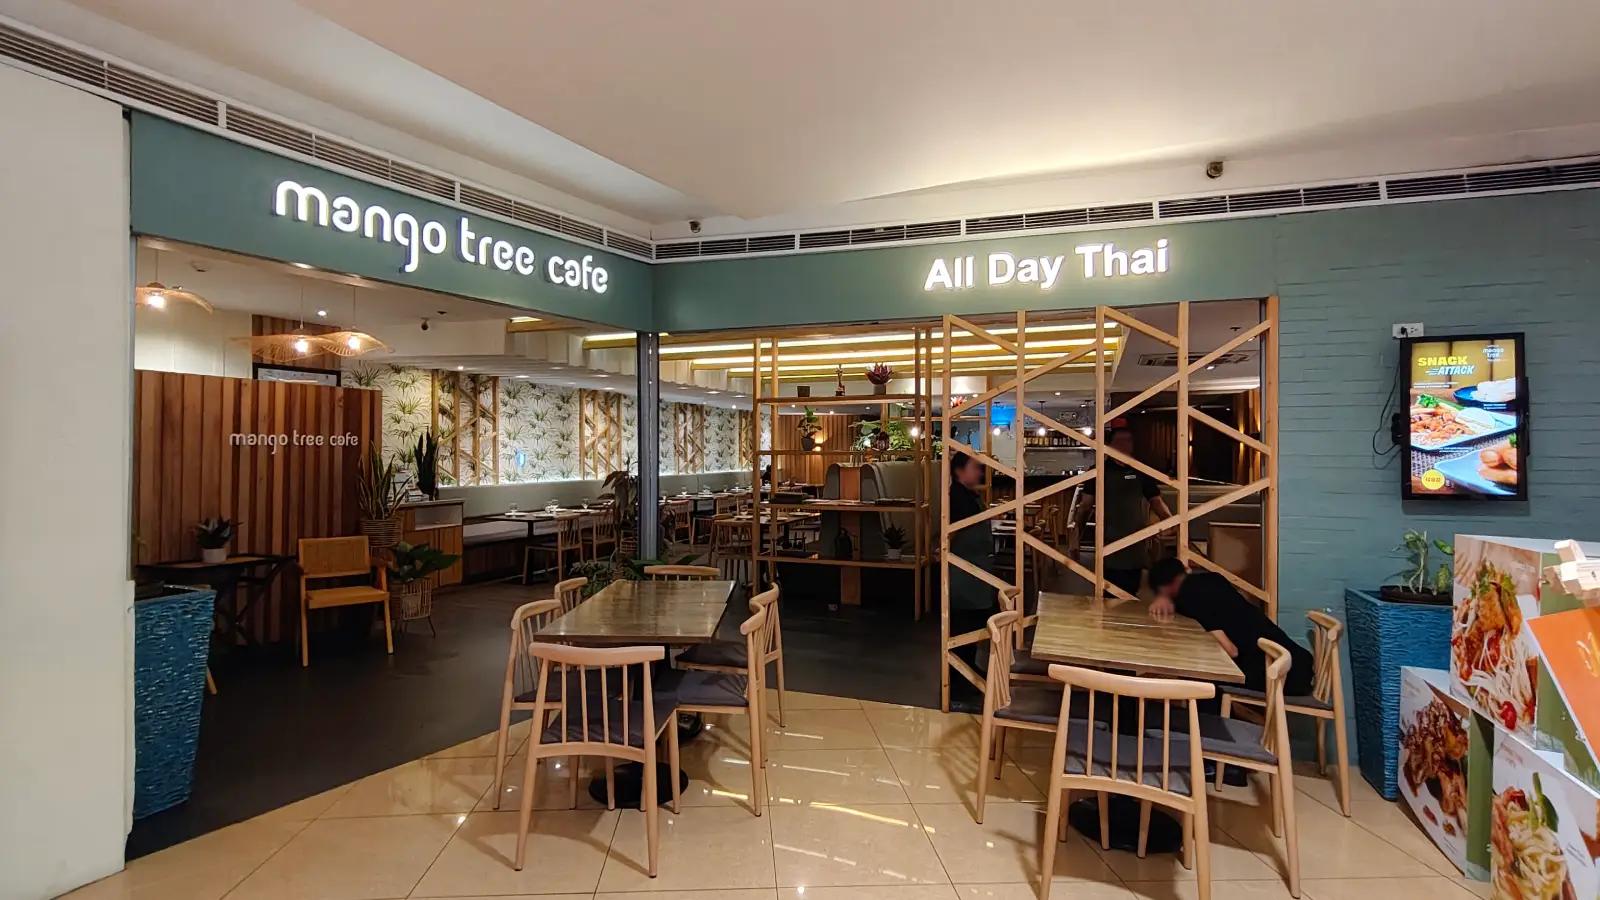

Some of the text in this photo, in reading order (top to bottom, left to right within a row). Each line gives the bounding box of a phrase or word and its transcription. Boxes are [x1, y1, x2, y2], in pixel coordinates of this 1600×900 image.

[275, 180, 609, 294] mango tree cafe
[924, 238, 1169, 291] All Day Thai
[1417, 355, 1469, 366] SNACK
[1437, 365, 1475, 375] ATTACK
[229, 429, 359, 455] mango tree cafe
